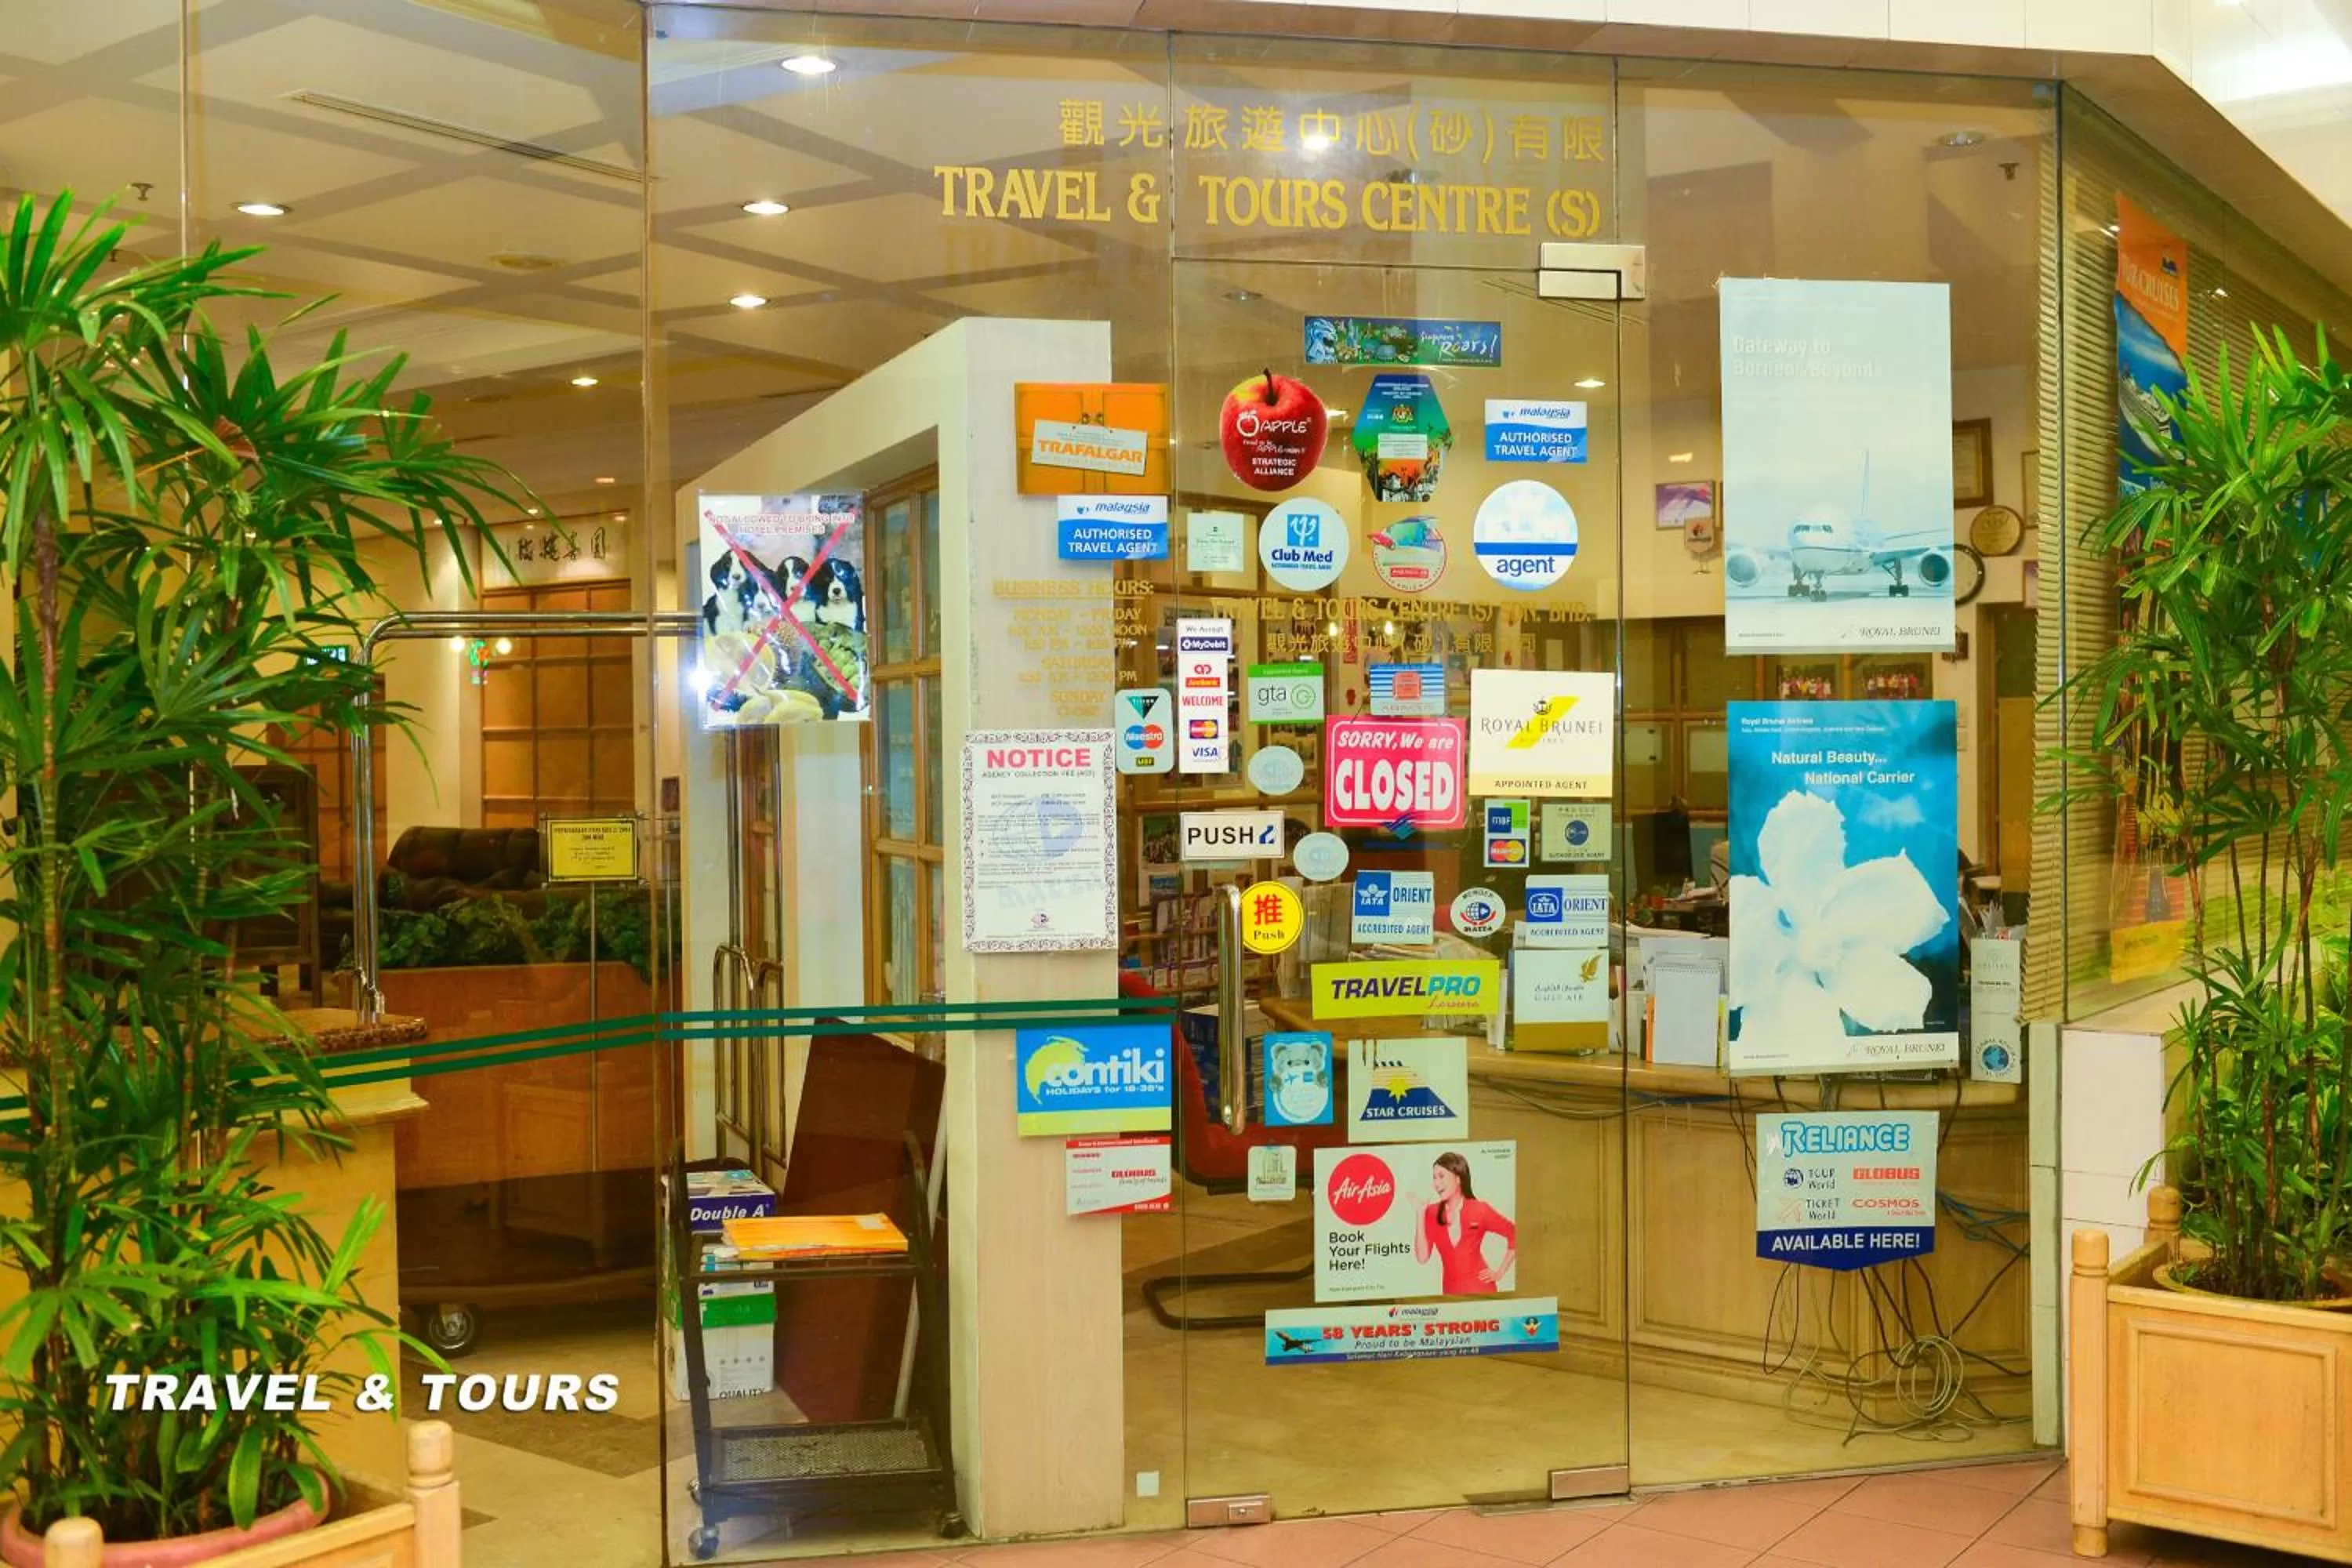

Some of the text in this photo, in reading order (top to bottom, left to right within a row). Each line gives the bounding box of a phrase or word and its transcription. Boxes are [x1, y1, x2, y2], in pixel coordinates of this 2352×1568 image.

[934, 165, 1601, 238] TRAVEL & TOURS CENTRE (S)
[1500, 432, 1572, 443] AUTHORISED
[1038, 438, 1143, 463] TRAFALGAR
[1494, 445, 1578, 459] TRAVEL AGENT
[1252, 458, 1297, 466] STRATEGIC
[1073, 528, 1152, 540] AUTHORISED
[1068, 542, 1159, 554] TRAVEL AGENT
[1271, 549, 1334, 562] Club Med
[1496, 557, 1555, 577] agent
[1293, 598, 1305, 620] &
[1192, 640, 1226, 650] MyDebit
[1181, 695, 1223, 706] WELCOME
[1258, 684, 1287, 706] gta
[1481, 717, 1602, 736] ROYAL BRUNEI
[1337, 730, 1455, 750] SORRY, We are
[986, 748, 1092, 768] NOTICE
[1192, 747, 1218, 757] VISA
[1771, 751, 1823, 764] Natural
[1806, 771, 1915, 784] National Carrier
[1335, 758, 1455, 813] CLOSED
[1494, 780, 1552, 789] APPOINTED
[1187, 826, 1254, 845] PUSH
[1360, 896, 1384, 906] IATA
[1393, 887, 1432, 903] ORIENT
[1254, 894, 1283, 926] 推
[1531, 902, 1555, 913] IATA
[1564, 898, 1607, 912] ORIENT
[1254, 930, 1285, 941] Push
[1356, 923, 1431, 935] ACCREDITED AGENT
[1331, 975, 1481, 1000] TRAVELPRO
[1044, 1047, 1166, 1087] contiki
[1046, 1087, 1102, 1096] HOLIDAYS
[1367, 1105, 1446, 1118] STAR CRUISES
[1780, 1120, 1911, 1158] RELIANCE
[1853, 1167, 1921, 1180] GLOBUS
[1809, 1179, 1836, 1190] World
[1806, 1197, 1840, 1209] TICKET
[1852, 1199, 1920, 1208] COSMOS
[690, 1203, 765, 1221] Double A
[1809, 1210, 1836, 1221] World
[1329, 1230, 1365, 1243] Book
[1771, 1232, 1921, 1253] AVAILABLE HERE!
[1329, 1242, 1410, 1257] Your Flights
[1329, 1258, 1366, 1271] Here!
[1350, 1323, 1417, 1339] YEARS'
[1424, 1319, 1501, 1336] STRONG
[1354, 1334, 1472, 1350] Proud to be Malaysian
[719, 1388, 766, 1400] QUALITY
